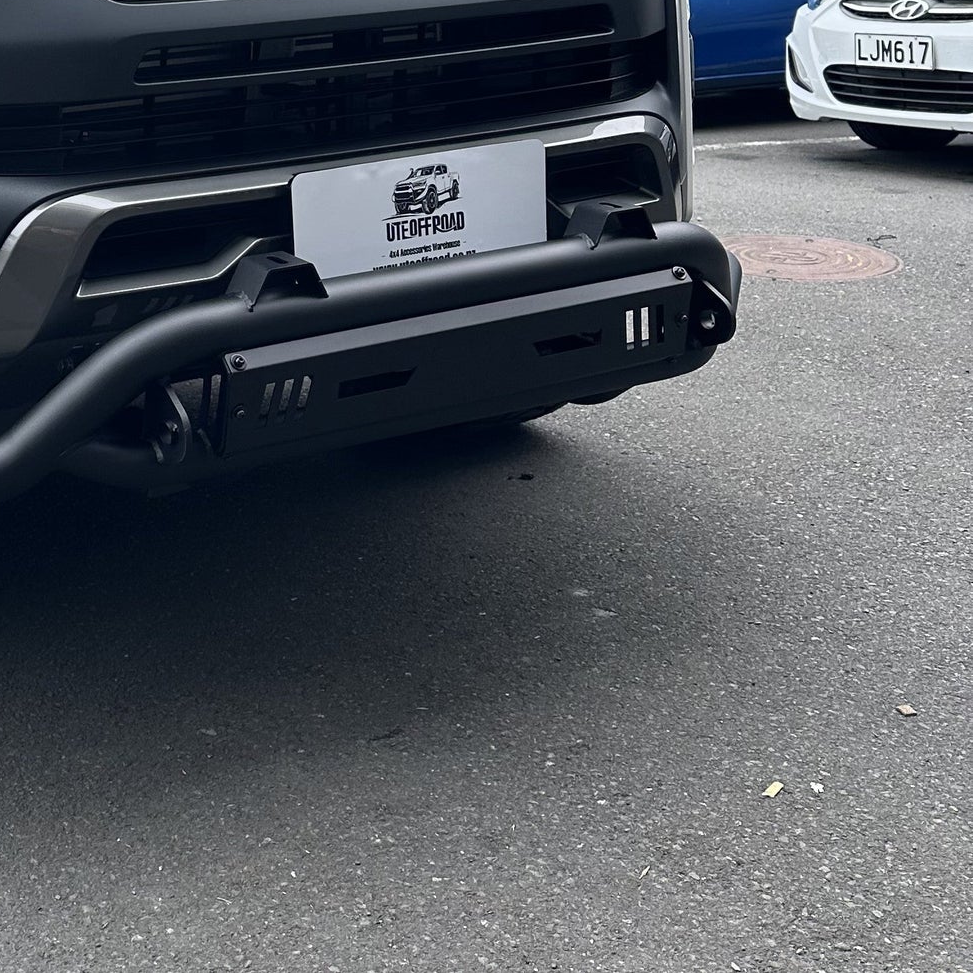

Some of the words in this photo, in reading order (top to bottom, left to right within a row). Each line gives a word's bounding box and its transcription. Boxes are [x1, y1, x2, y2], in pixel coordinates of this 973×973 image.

[857, 39, 929, 64] LJM617
[386, 211, 465, 242] UTEOFFROAD
[389, 250, 400, 259] 4x4
[400, 243, 432, 257] Accessories
[432, 240, 461, 252] Warehouse
